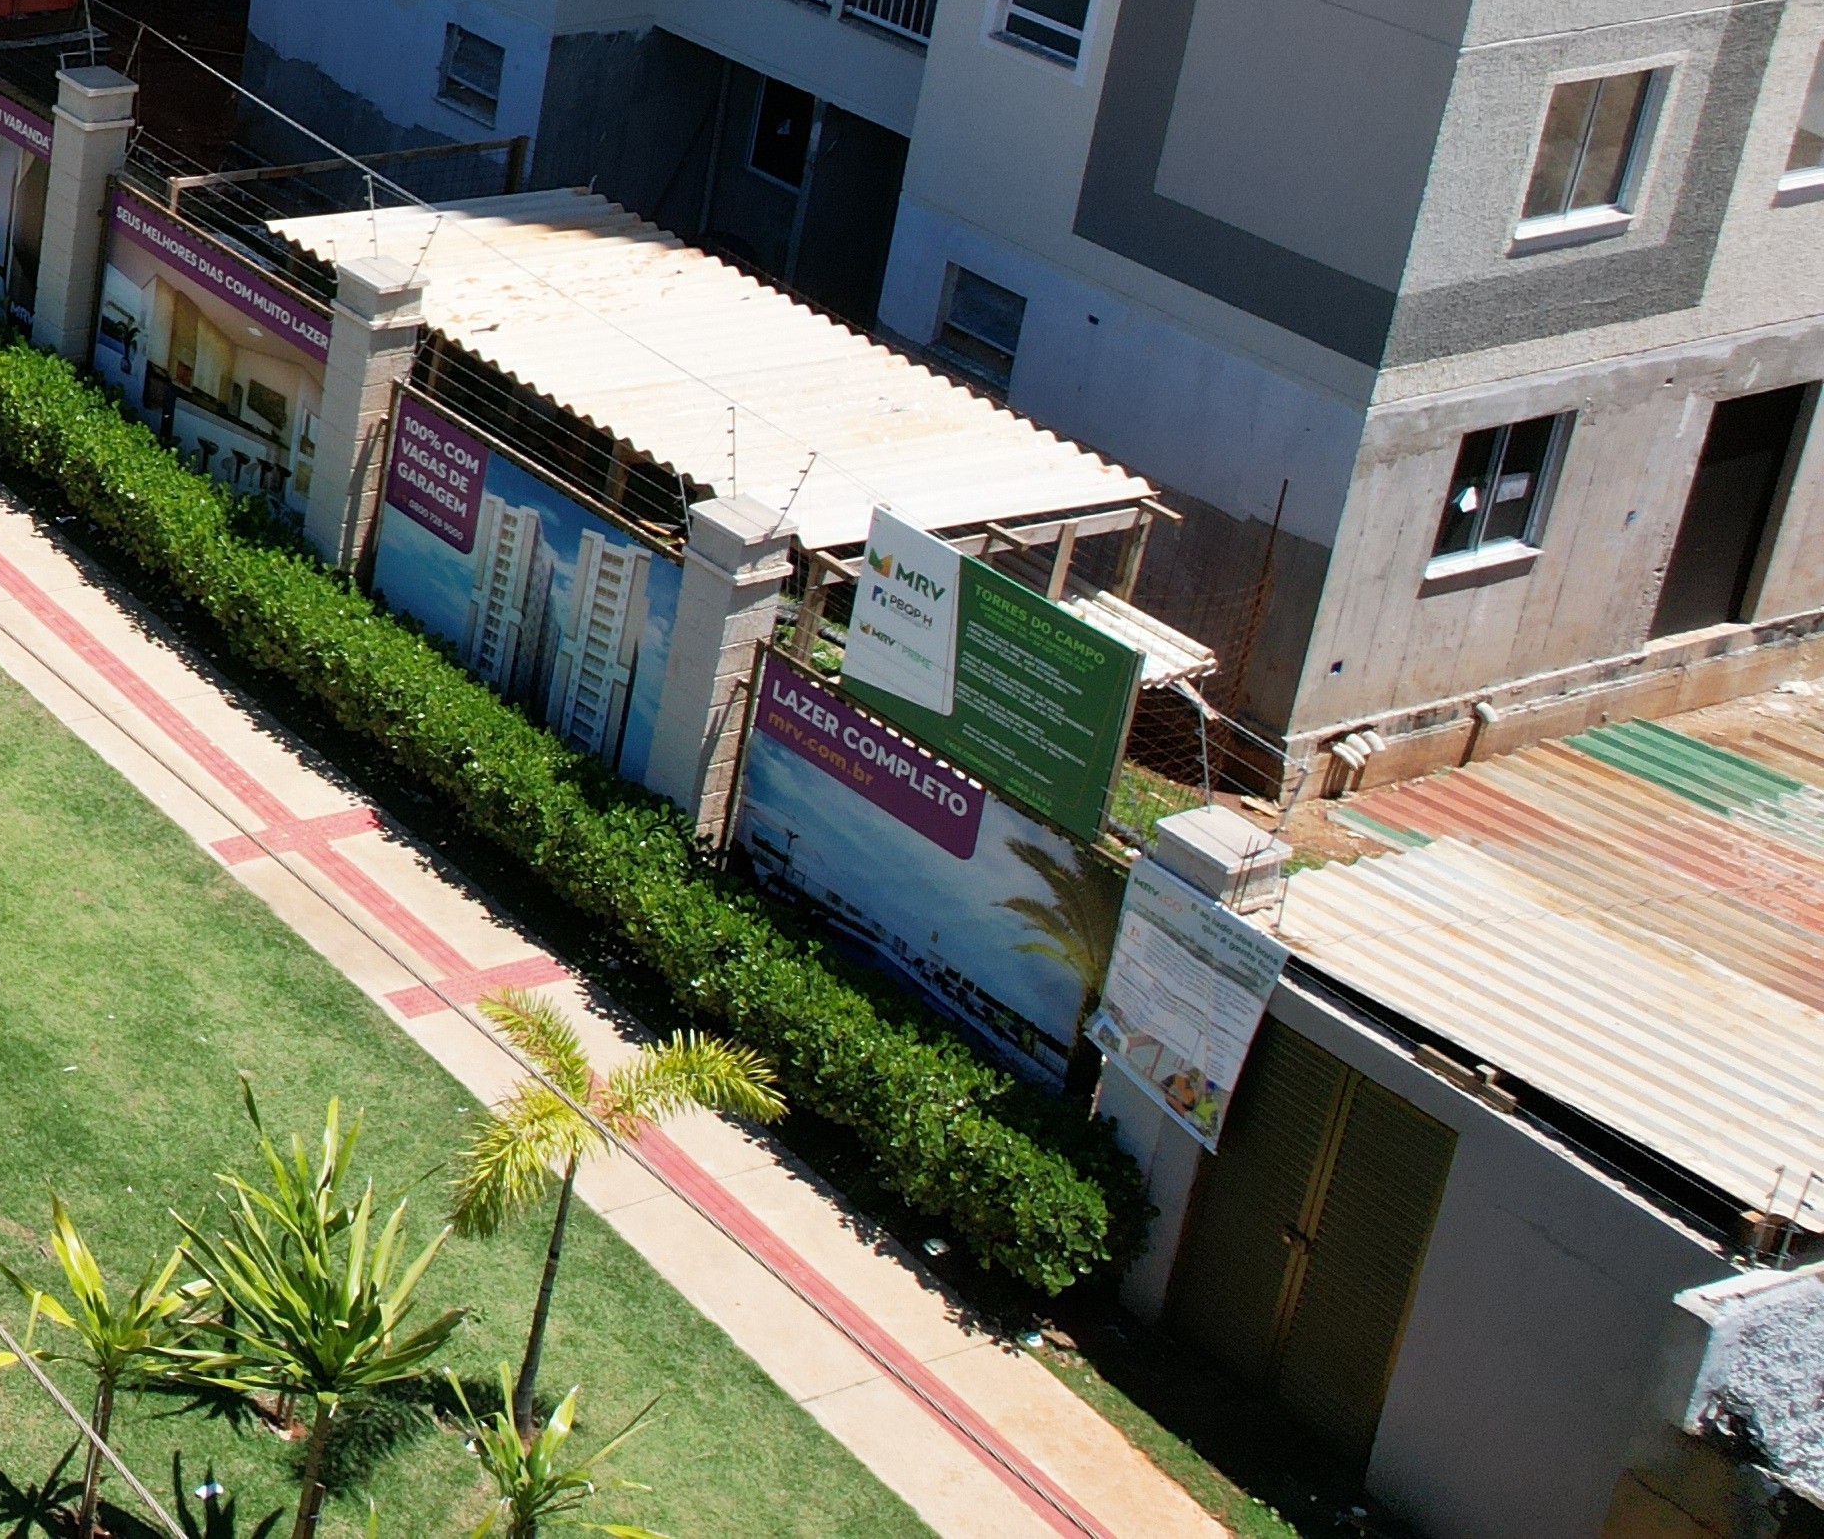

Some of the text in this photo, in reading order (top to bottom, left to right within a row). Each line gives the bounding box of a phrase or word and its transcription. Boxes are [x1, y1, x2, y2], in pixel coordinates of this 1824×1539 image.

[115, 206, 329, 350] SEUS MELHORES DIAS COM MUITO LAZER
[401, 437, 470, 494] VAGAS DE
[404, 416, 480, 475] 100% COM
[397, 461, 468, 519] GARAGEM
[895, 561, 946, 603] MRV
[974, 583, 1028, 623] TORRES
[1030, 615, 1051, 635] DO
[1054, 630, 1106, 666] CAMPO
[767, 711, 874, 786] mrv.com.br
[772, 679, 840, 739] LAZER
[842, 726, 969, 818] COMPLETO
